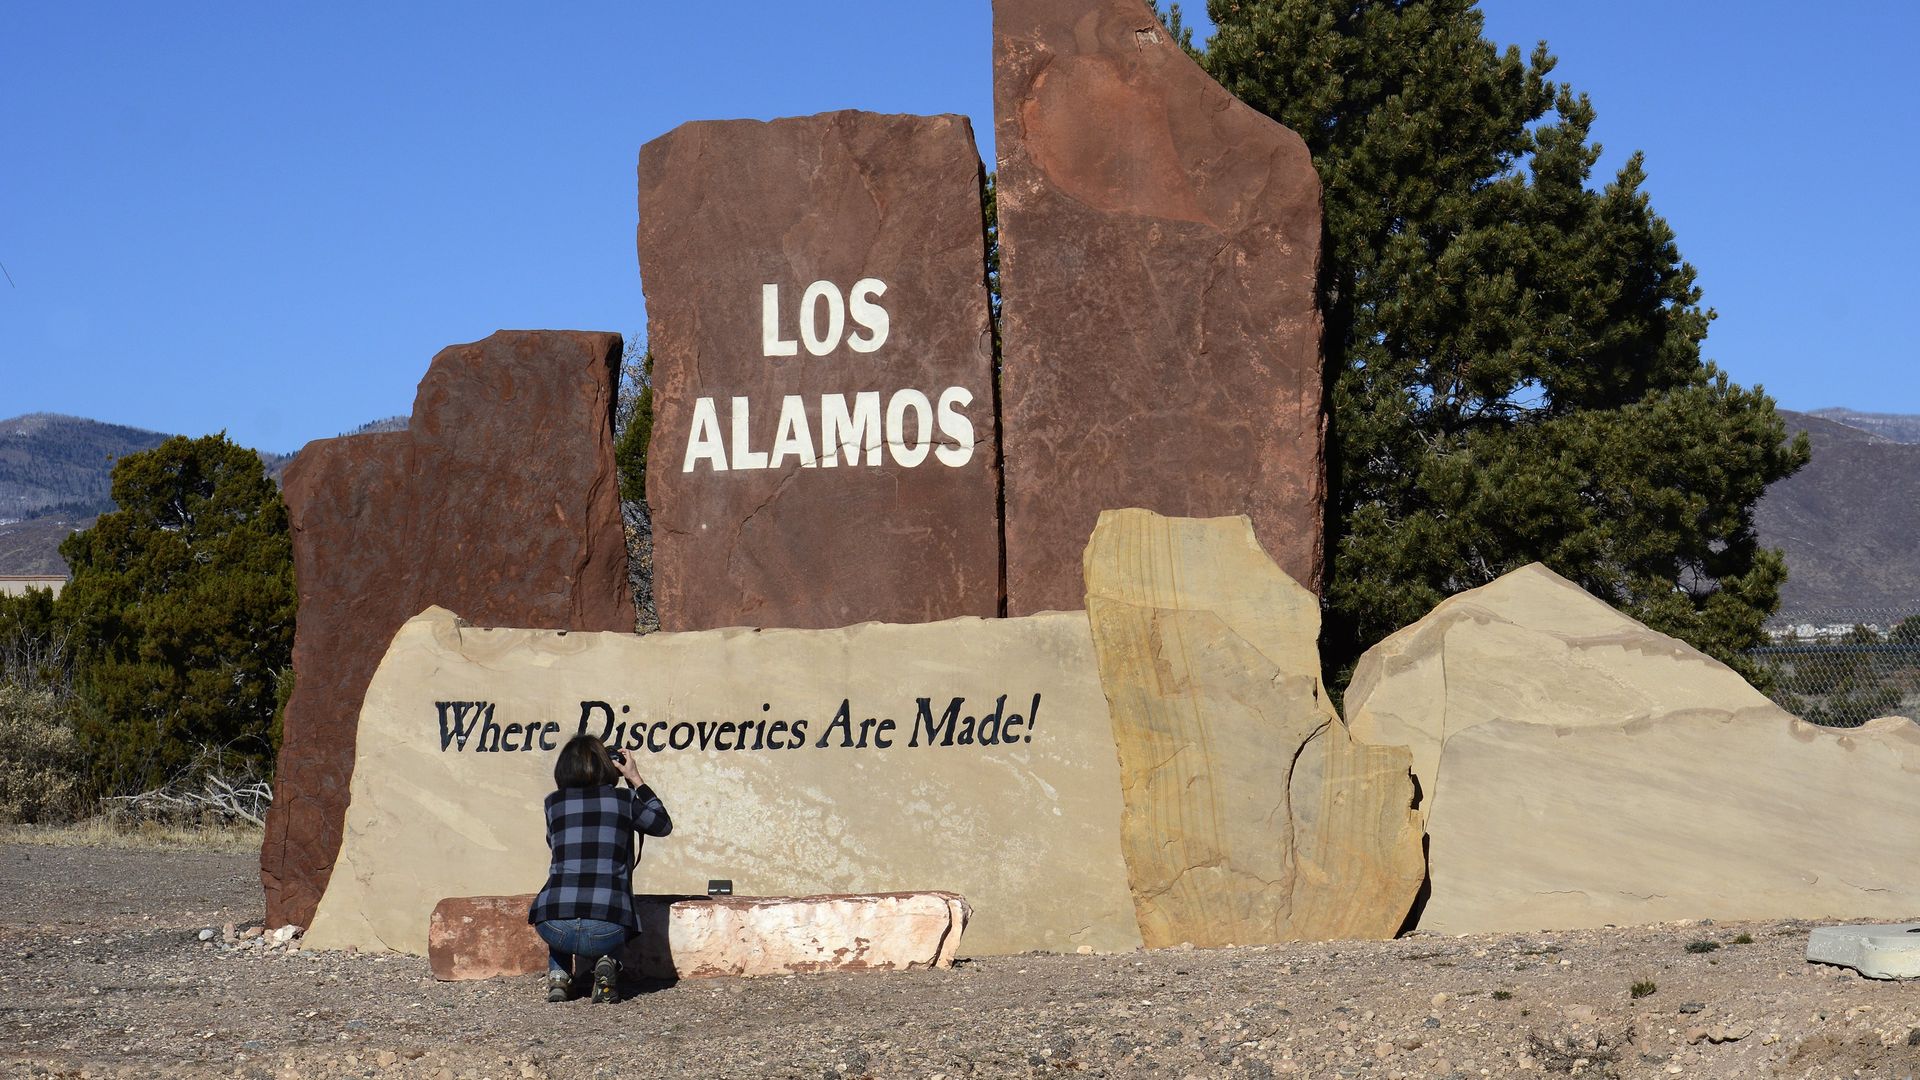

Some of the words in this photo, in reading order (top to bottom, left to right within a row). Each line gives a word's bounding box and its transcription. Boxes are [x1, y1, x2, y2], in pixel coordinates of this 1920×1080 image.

[763, 278, 890, 357] LOS
[682, 386, 975, 473] ALAMOS
[434, 701, 560, 752] Where
[577, 701, 808, 753] Discoveries
[815, 698, 896, 749] Are
[908, 693, 1041, 747] Made!
